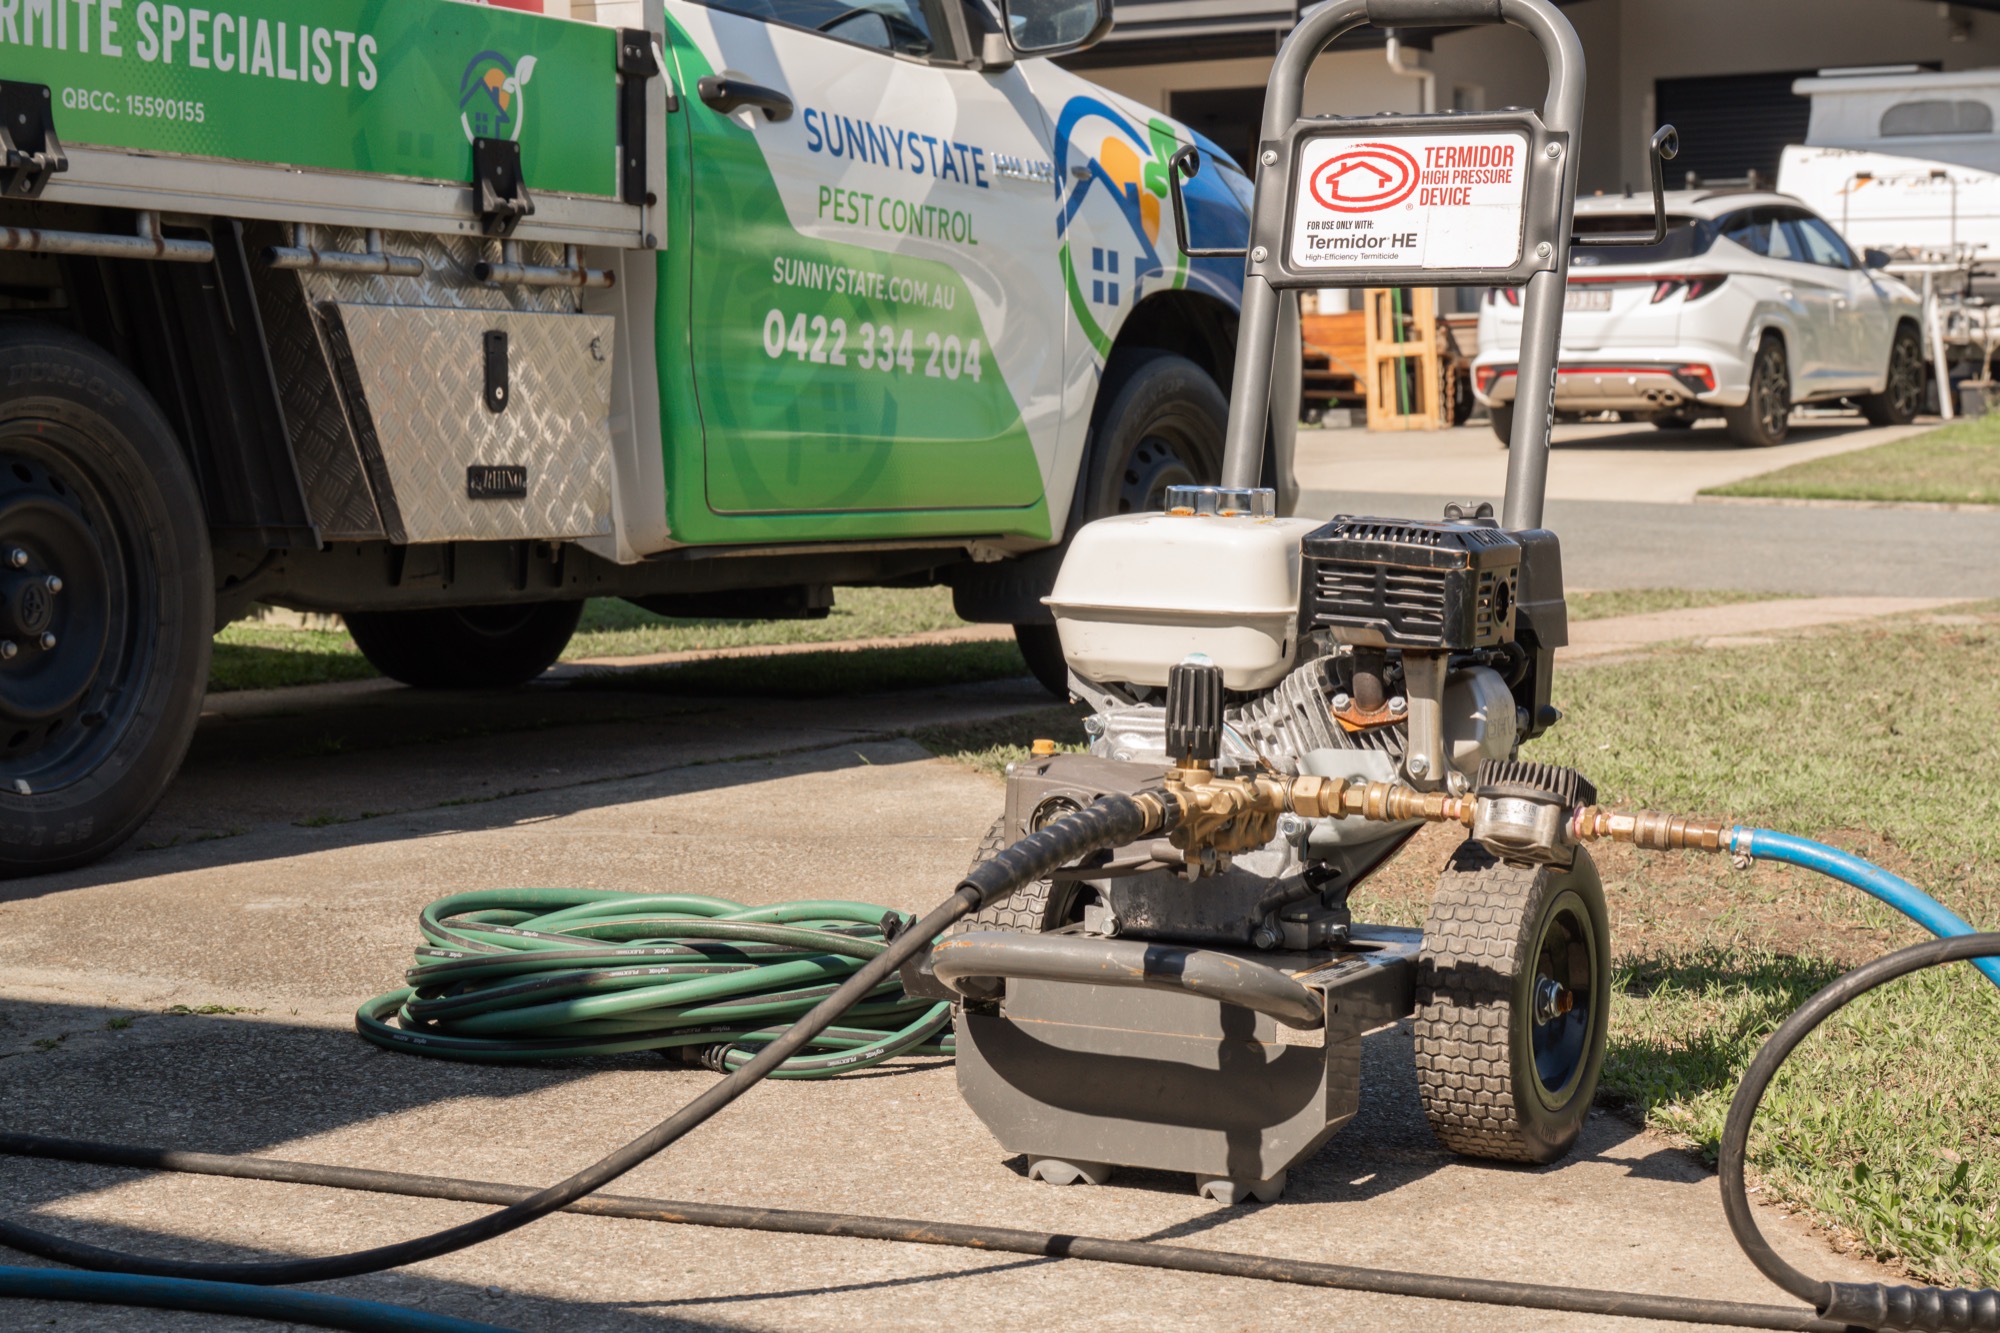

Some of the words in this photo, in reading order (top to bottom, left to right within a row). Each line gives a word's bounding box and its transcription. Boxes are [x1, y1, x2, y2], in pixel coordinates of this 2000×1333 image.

[0, 0, 122, 57] RMITE
[136, 1, 378, 91] SPECIALISTS
[62, 87, 120, 113] QBCC:
[126, 94, 205, 123] 15590155
[803, 107, 989, 189] SUNNYSTATE
[1424, 145, 1515, 168] TERMIDOR
[1421, 170, 1449, 185] HIGH
[1452, 169, 1513, 184] PRESSURE
[1419, 187, 1472, 206] DEVICE
[819, 185, 874, 226] PEST
[878, 197, 978, 245] CONTROL
[1307, 221, 1320, 230] FOR
[1321, 221, 1335, 230] USE
[1336, 220, 1353, 230] ONLY
[1354, 220, 1374, 230] WITH:
[1307, 234, 1386, 250] Termidor
[1392, 233, 1418, 248] HE
[1305, 253, 1358, 261] High-Efficiency
[1360, 252, 1399, 260] Termiticide
[772, 256, 955, 310] SUNNYSTATE.COM.AU
[763, 308, 847, 366] 0422
[857, 322, 915, 375] 334
[924, 331, 983, 383] 204
